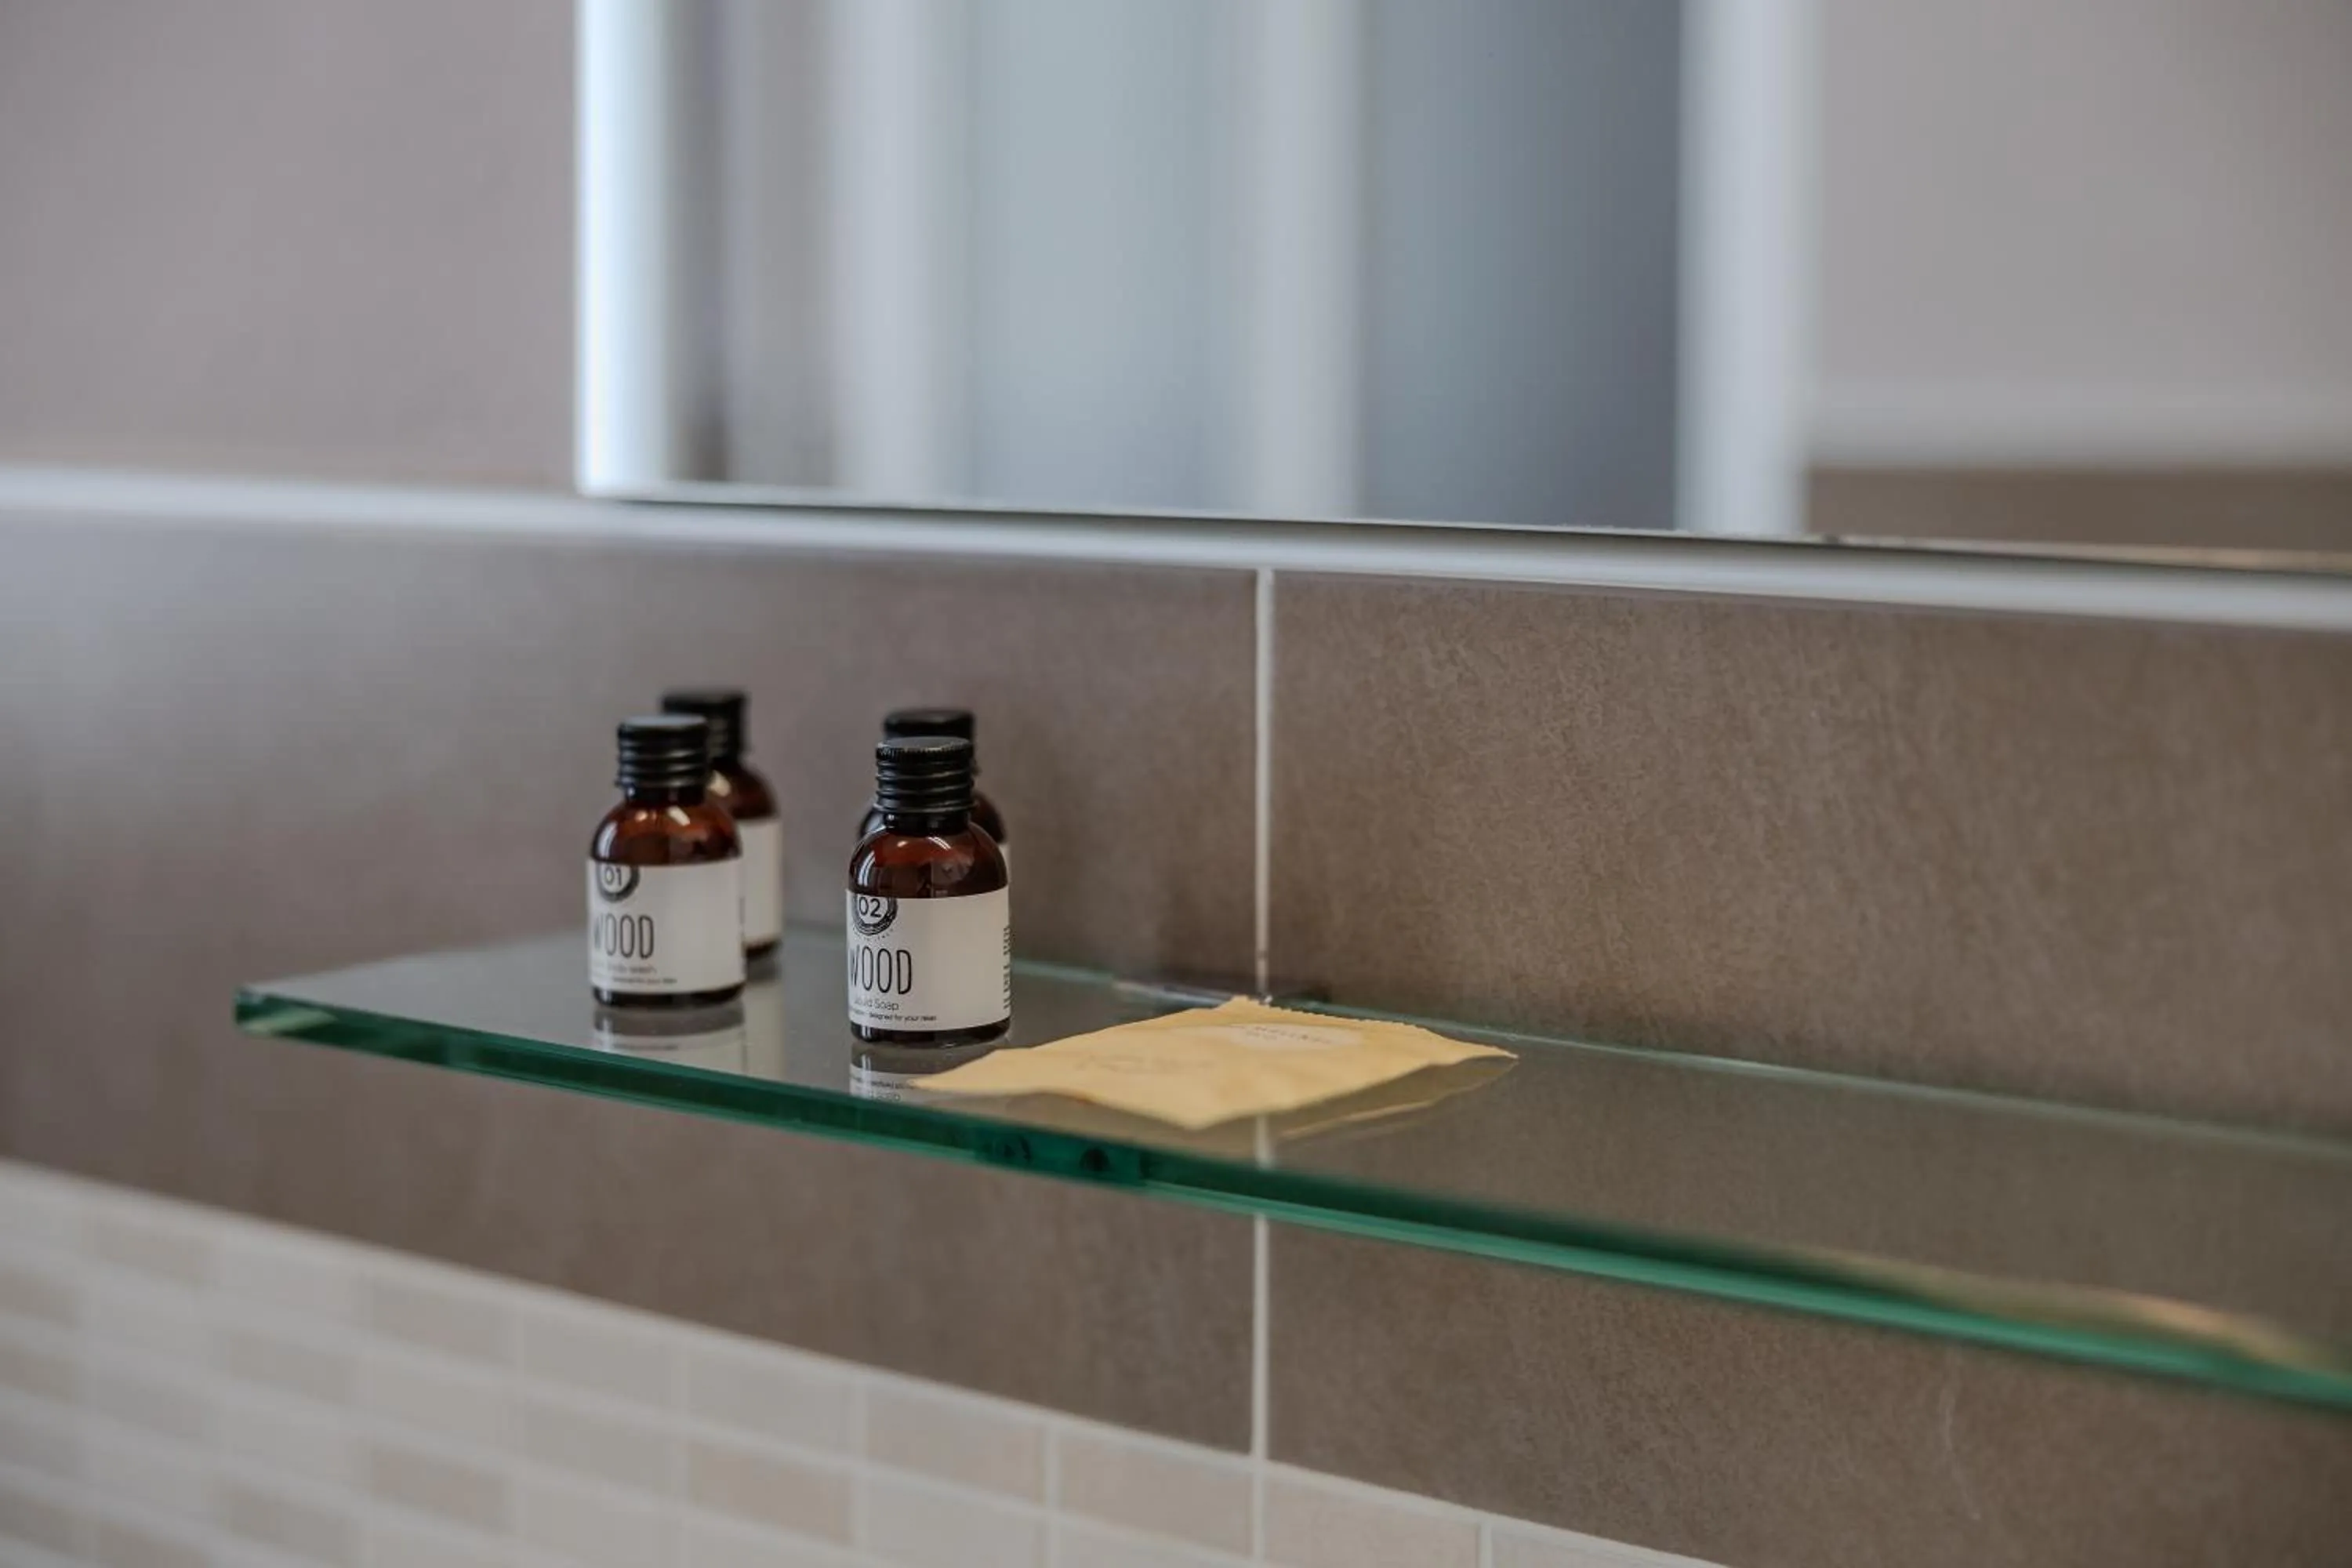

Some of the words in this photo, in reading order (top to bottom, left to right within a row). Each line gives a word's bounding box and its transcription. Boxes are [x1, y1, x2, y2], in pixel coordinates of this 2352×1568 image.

[604, 866, 622, 887] 01
[858, 896, 881, 918] 02
[874, 998, 899, 1011] Soap
